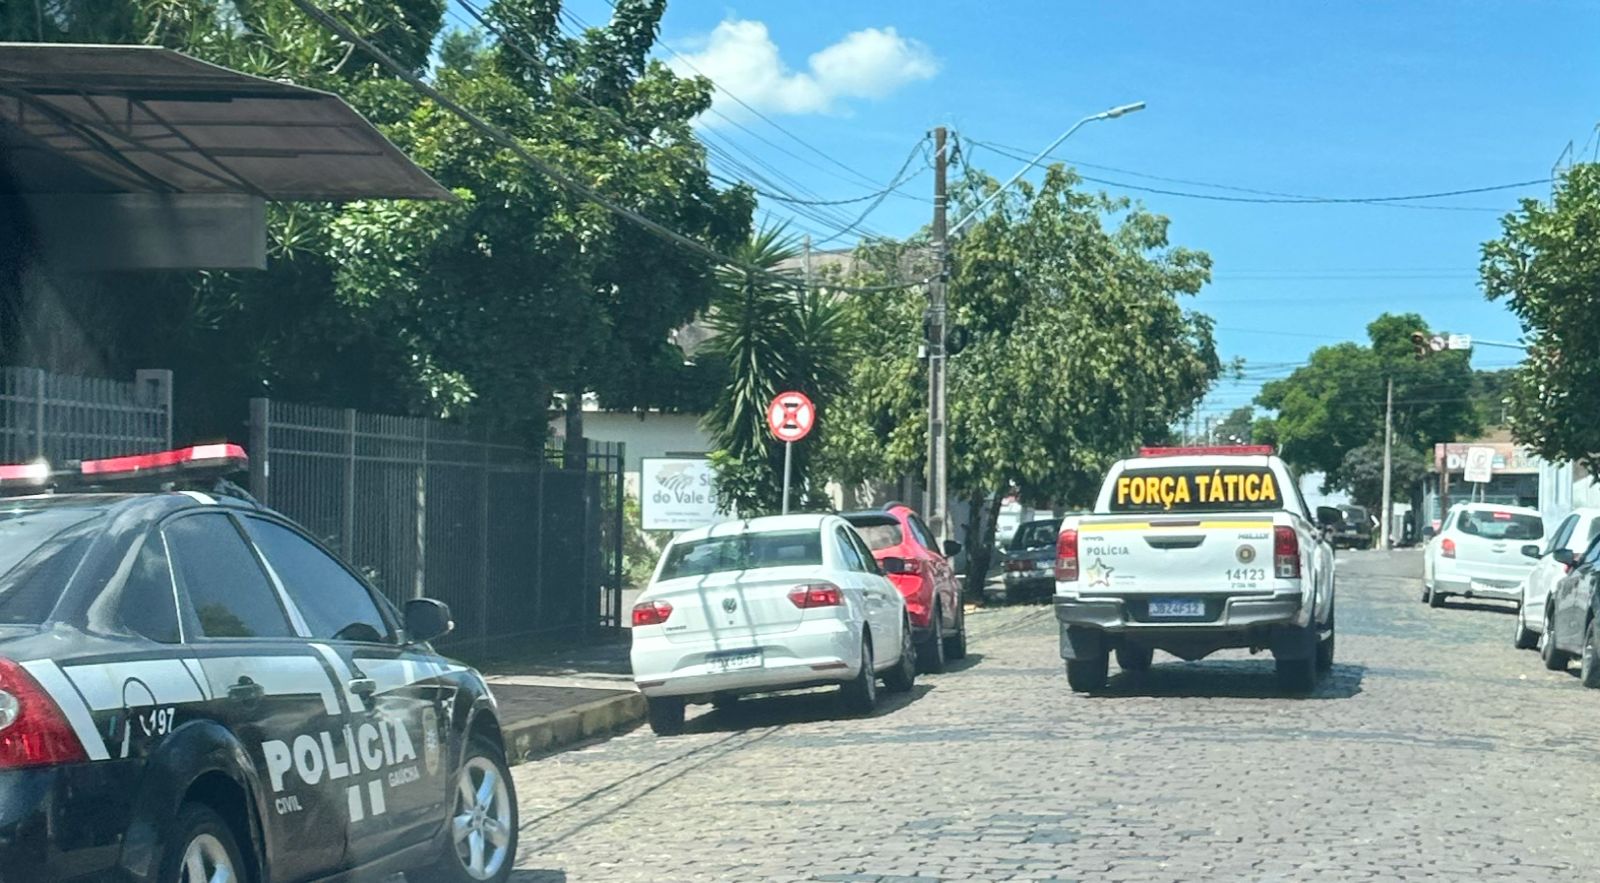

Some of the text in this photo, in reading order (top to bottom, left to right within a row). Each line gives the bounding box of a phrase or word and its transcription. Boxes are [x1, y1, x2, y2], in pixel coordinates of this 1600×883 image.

[652, 490, 671, 504] do
[674, 491, 704, 504] Vale
[1117, 469, 1276, 510] FORÇA TÁTICA
[1087, 545, 1130, 556] POLÍCIA
[1225, 568, 1265, 581] 14123
[149, 707, 175, 736] 197
[275, 794, 303, 815] CIVIL
